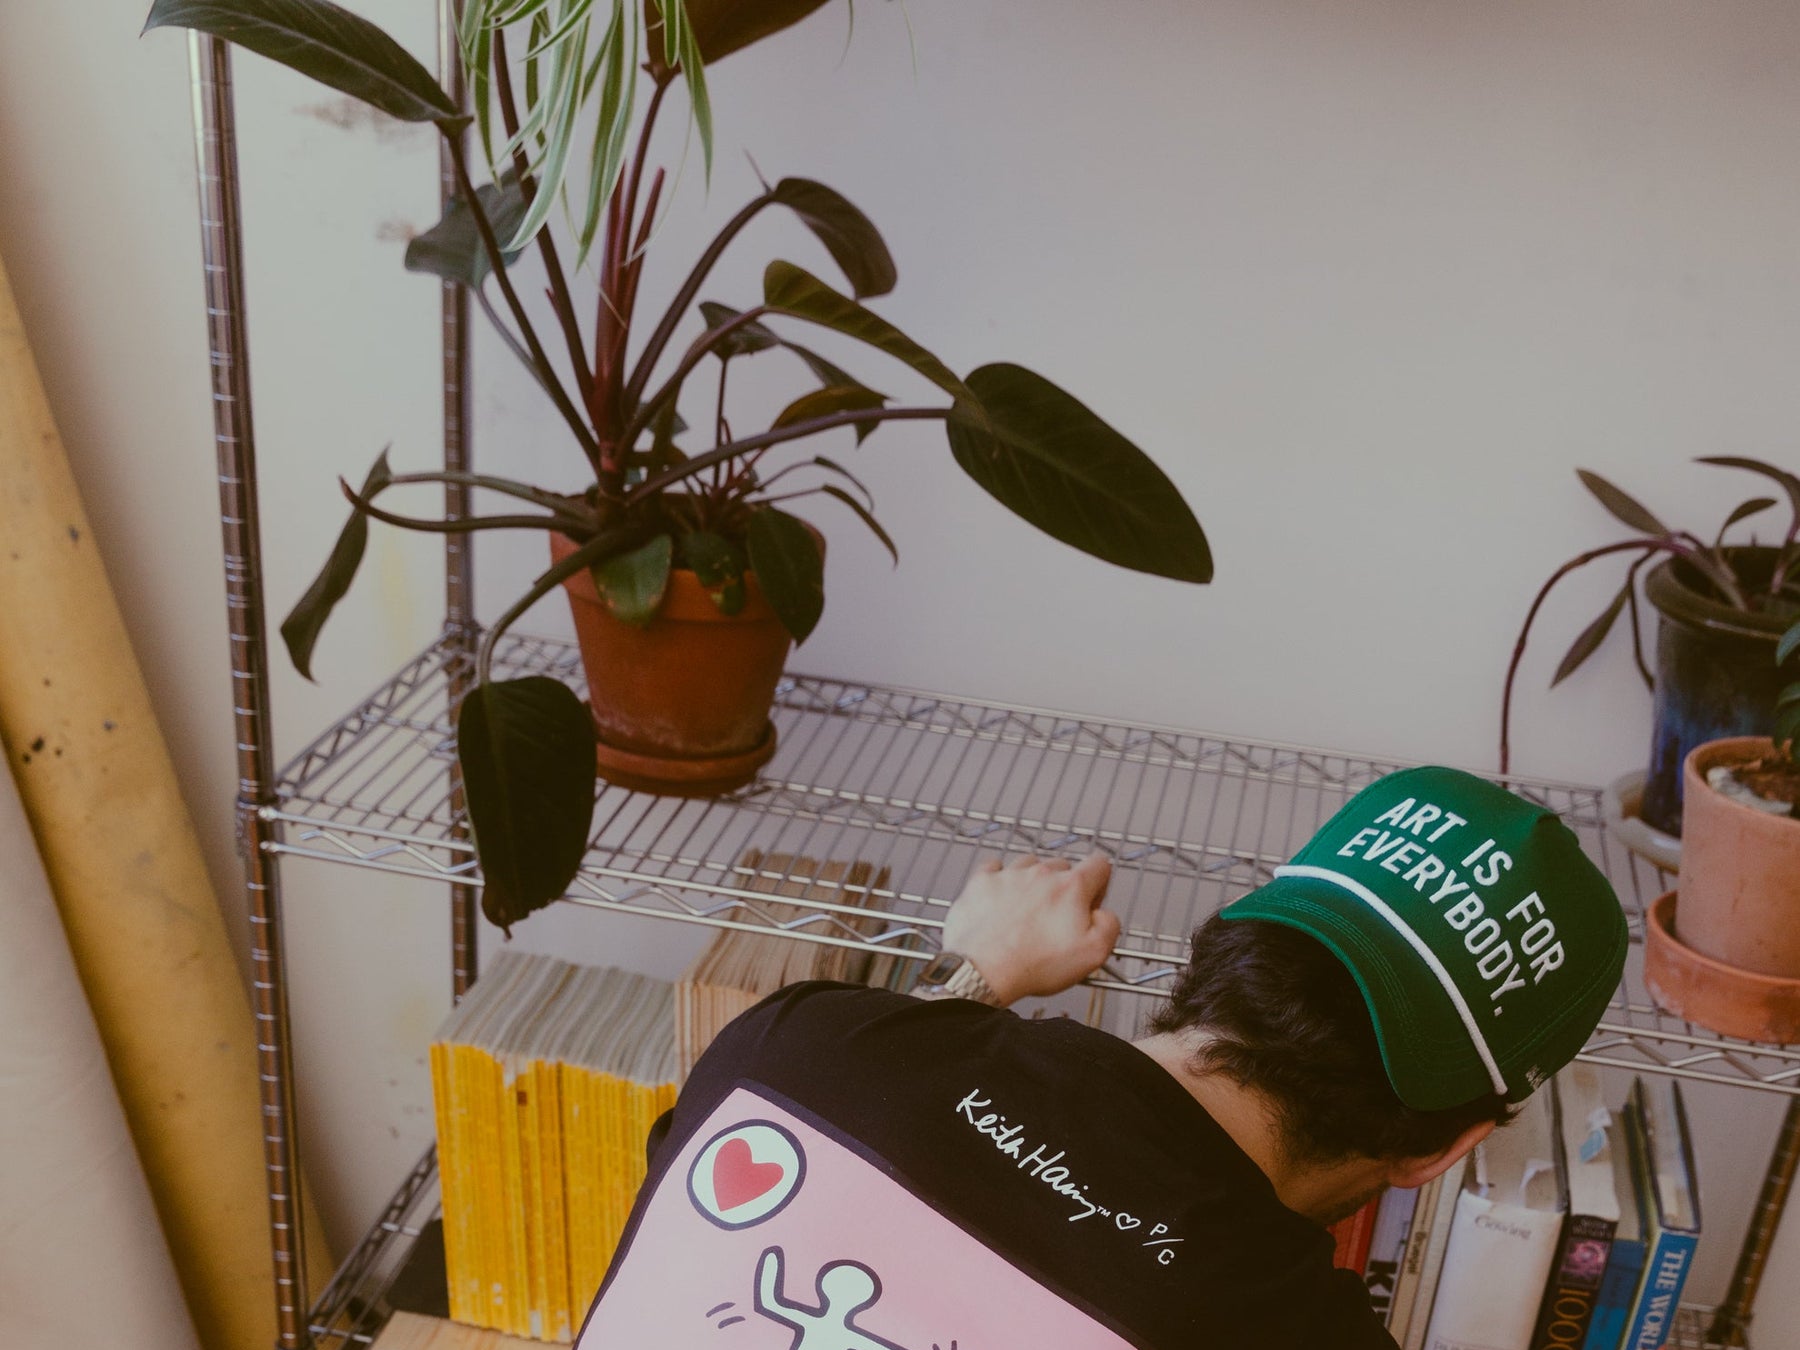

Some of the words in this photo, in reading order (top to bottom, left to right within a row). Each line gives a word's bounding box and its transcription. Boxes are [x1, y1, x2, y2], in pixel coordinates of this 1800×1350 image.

[1336, 827, 1526, 1016] EVERYBODY.
[1373, 797, 1468, 844] ART
[1461, 838, 1513, 886] IS
[1506, 891, 1565, 985] FOR
[955, 1088, 1025, 1159] Keith
[1654, 1248, 1687, 1292] THE
